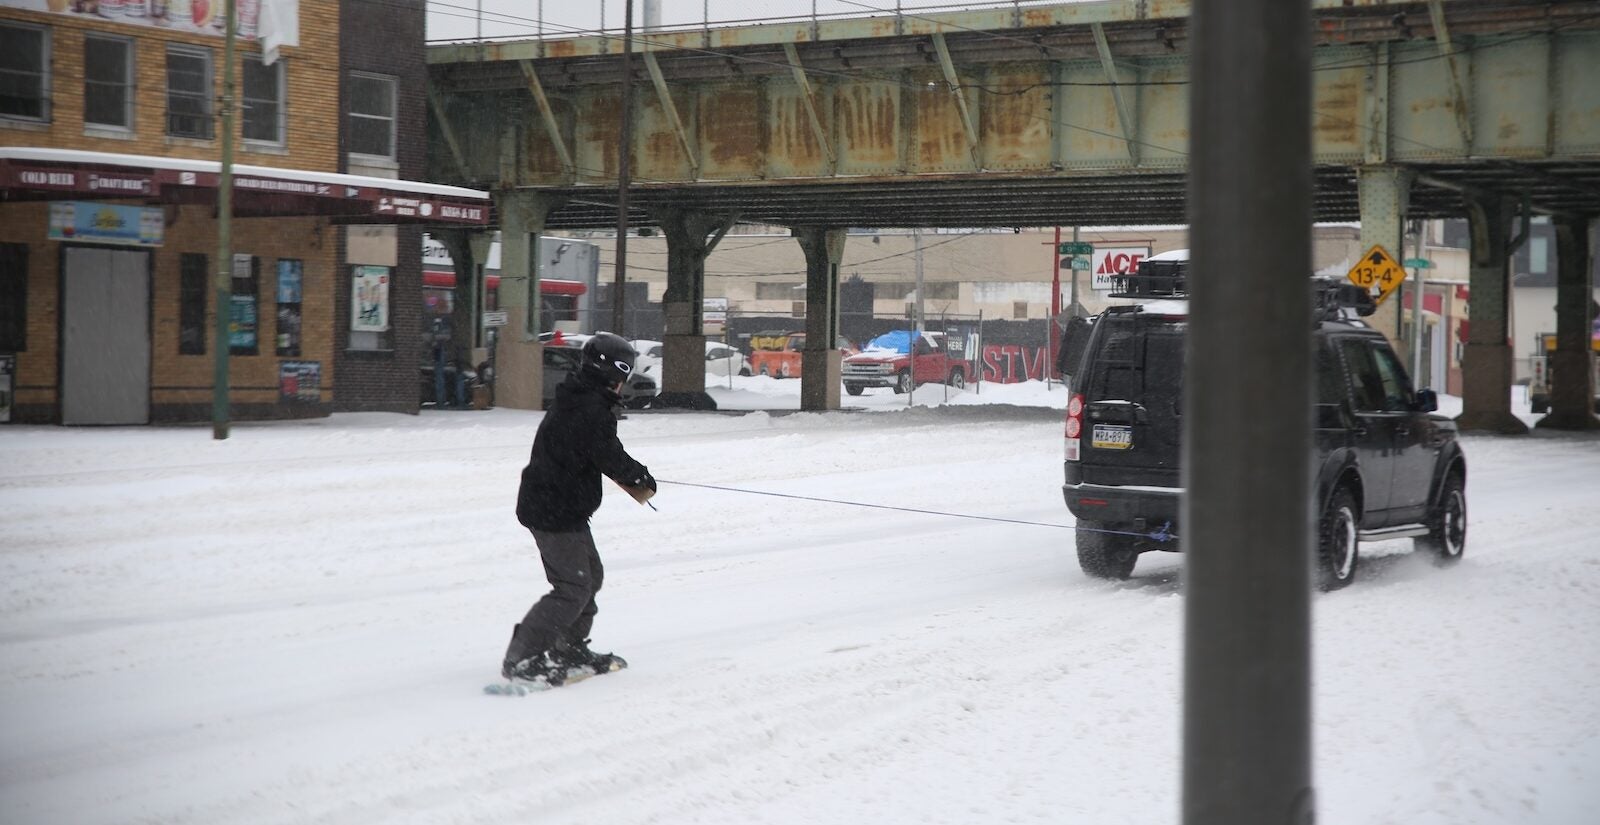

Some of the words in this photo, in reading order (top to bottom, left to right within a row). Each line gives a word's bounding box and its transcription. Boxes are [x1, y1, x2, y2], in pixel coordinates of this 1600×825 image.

[21, 171, 47, 184] COLD
[48, 172, 75, 186] BEER
[1096, 250, 1144, 274] ACE
[947, 341, 963, 351] HERE
